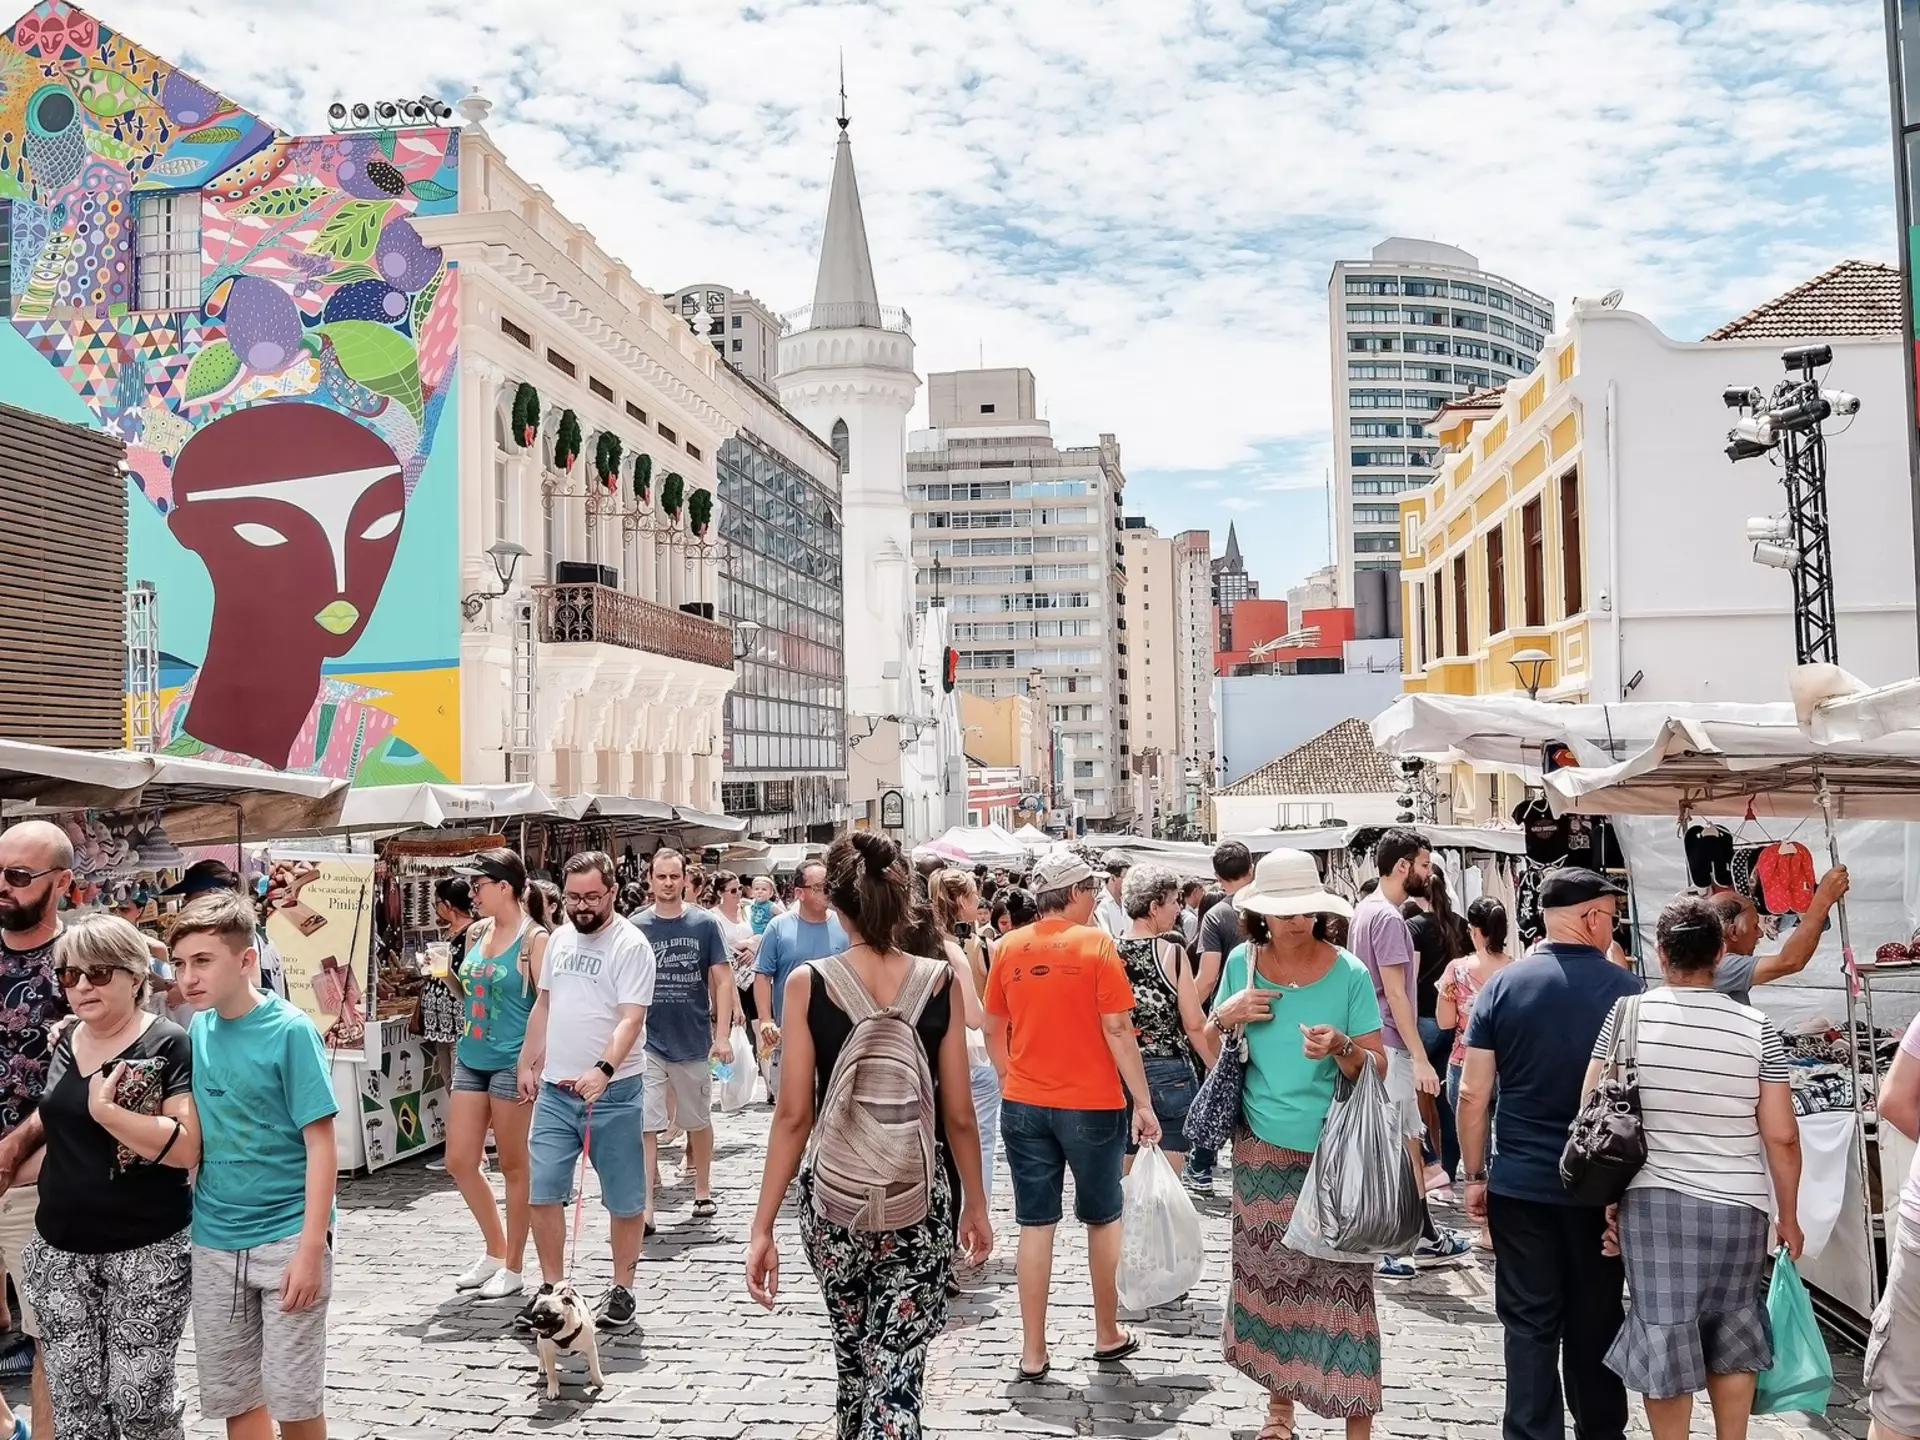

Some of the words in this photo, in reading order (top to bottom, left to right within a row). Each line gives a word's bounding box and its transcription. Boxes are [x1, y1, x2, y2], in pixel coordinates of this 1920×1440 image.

[322, 873, 331, 881] O
[670, 937, 700, 951] EDITION
[282, 955, 298, 963] tico
[284, 964, 306, 976] ebra
